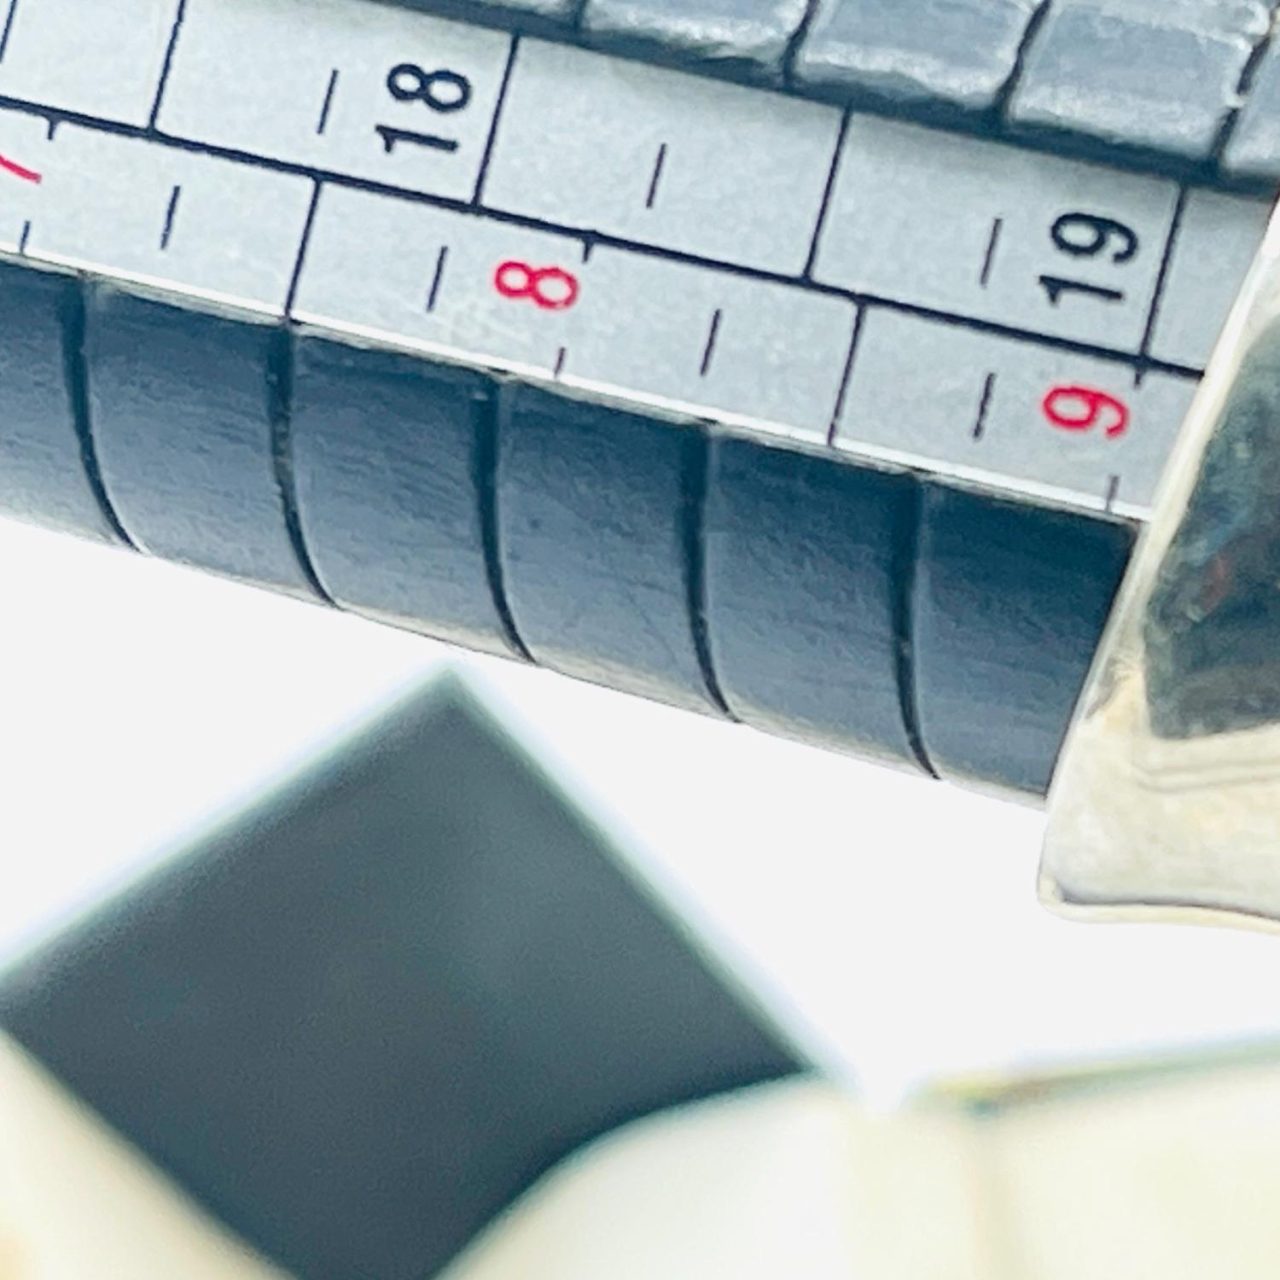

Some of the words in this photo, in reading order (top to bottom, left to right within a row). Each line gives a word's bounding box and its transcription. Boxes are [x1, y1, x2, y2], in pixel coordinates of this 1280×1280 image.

[375, 63, 471, 153] 18
[494, 260, 579, 310] 8
[1039, 212, 1138, 305] 19
[1041, 386, 1129, 438] 9
